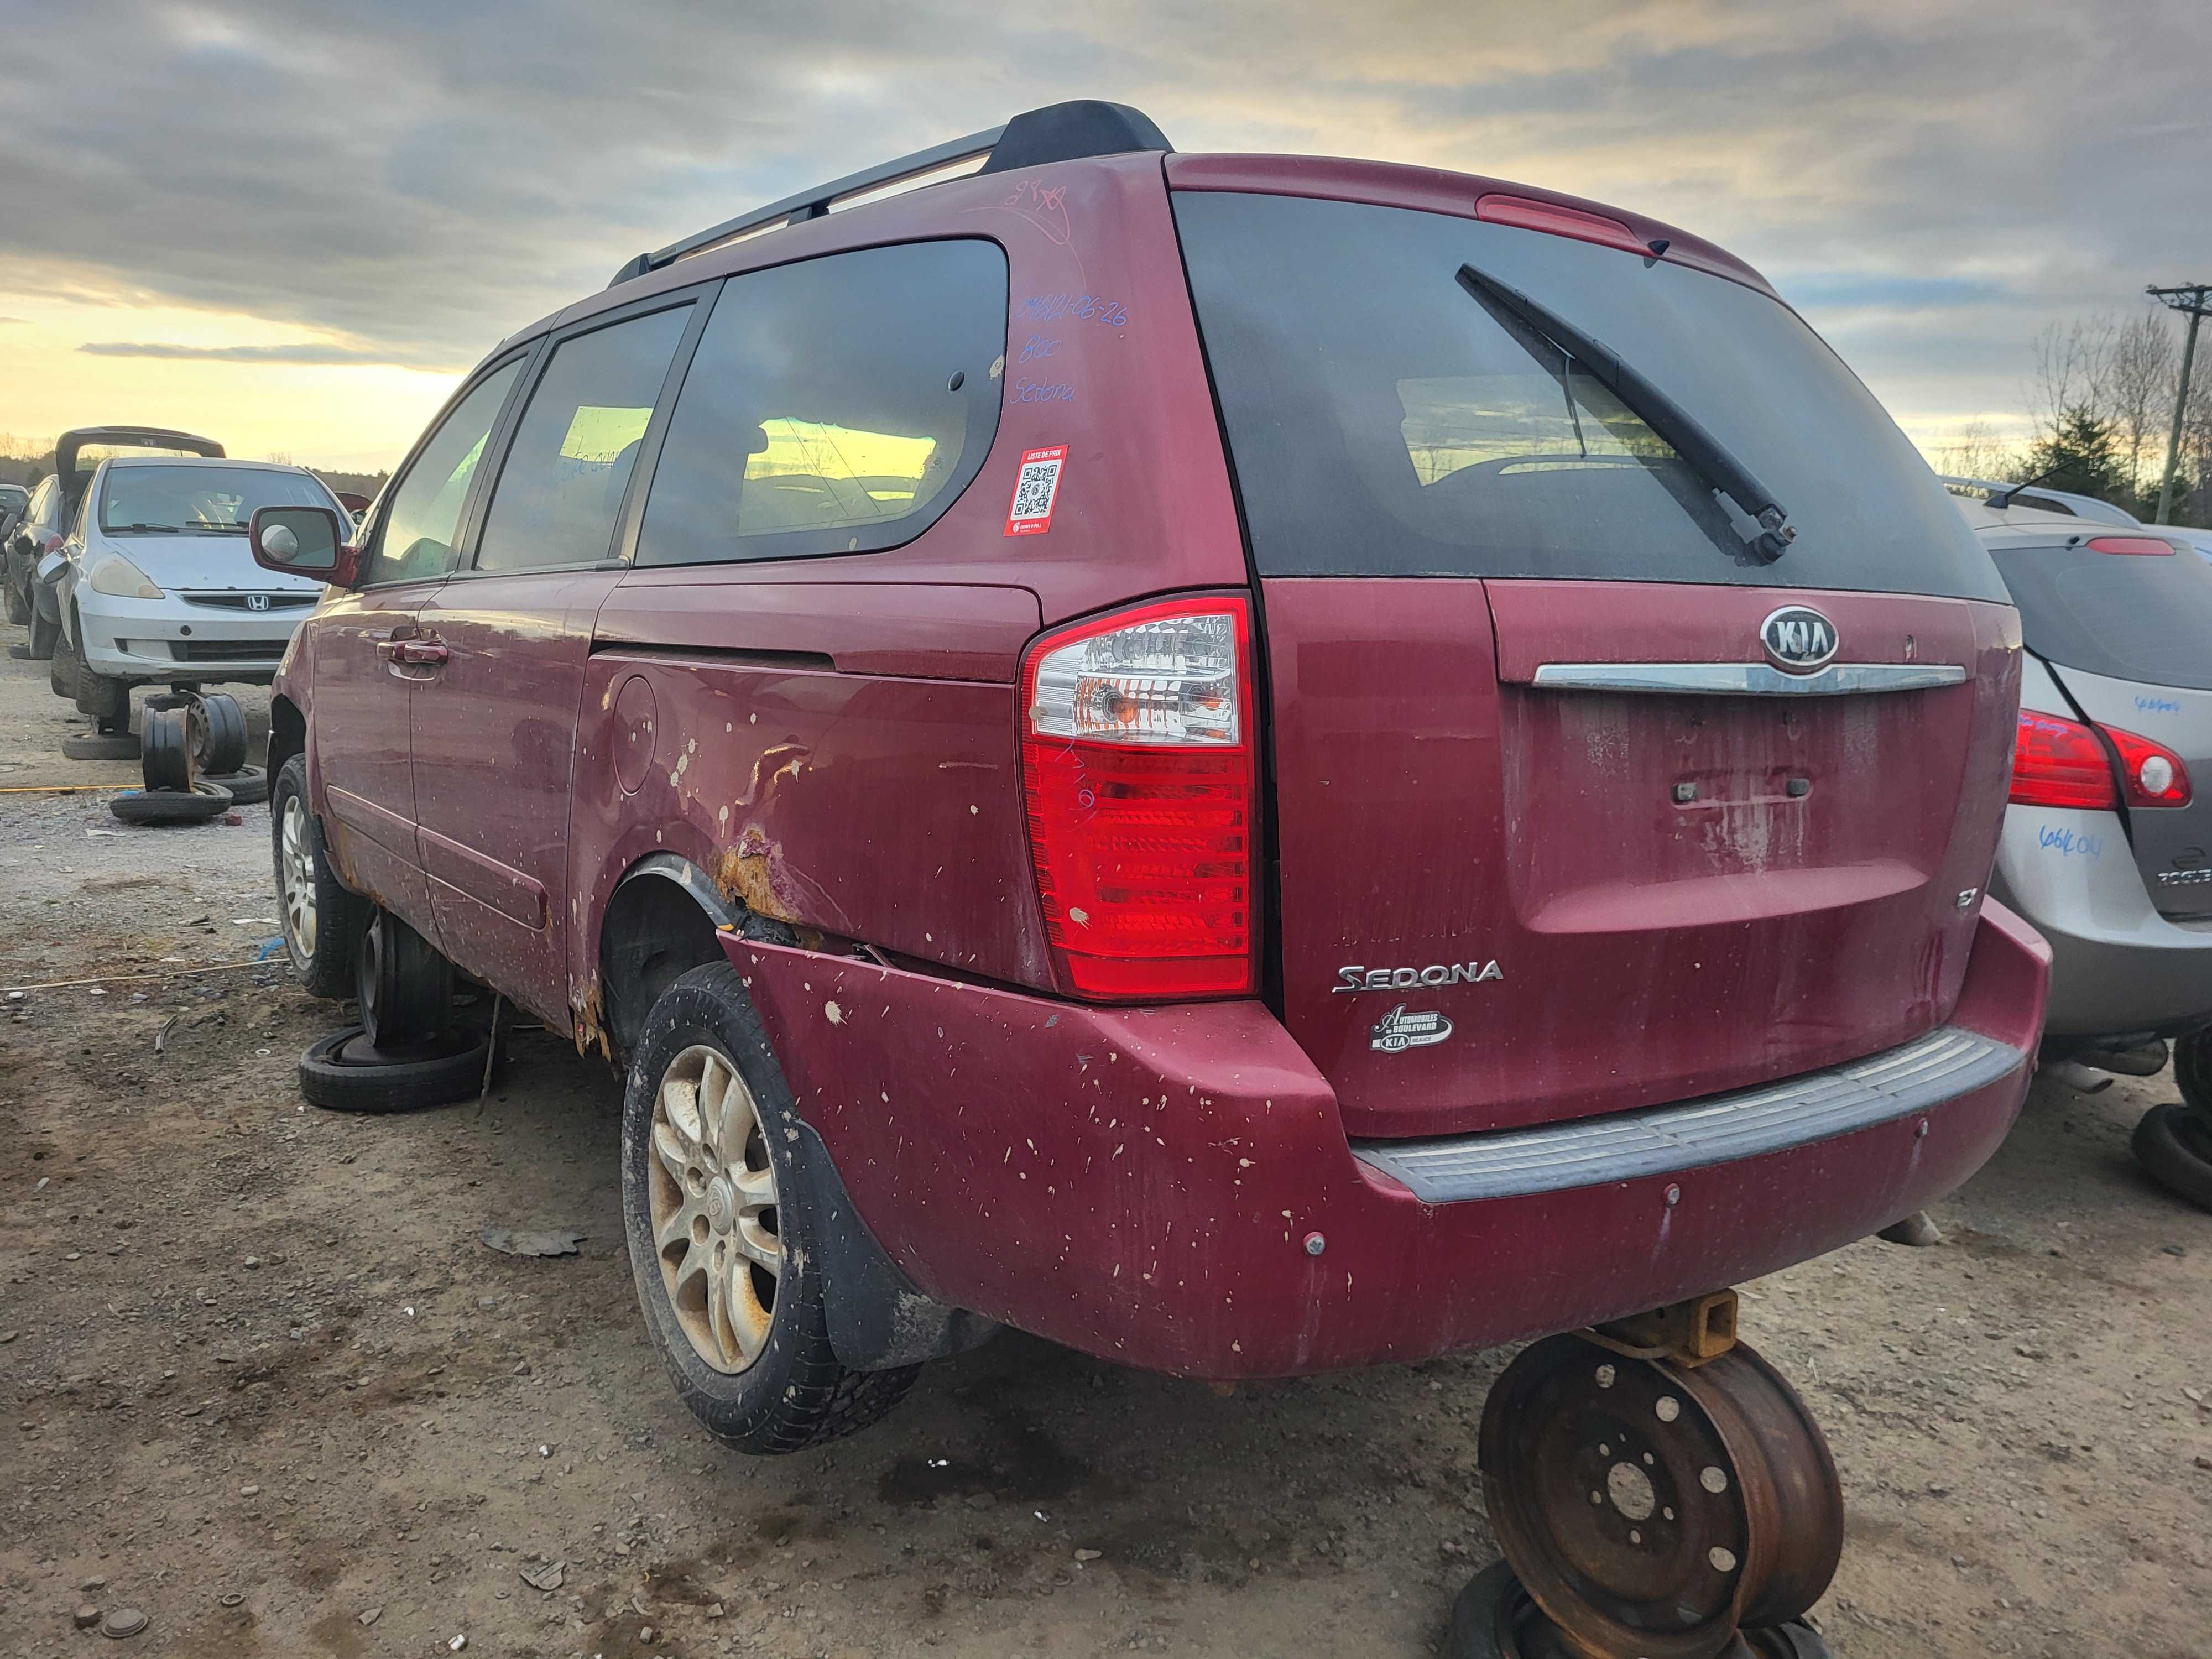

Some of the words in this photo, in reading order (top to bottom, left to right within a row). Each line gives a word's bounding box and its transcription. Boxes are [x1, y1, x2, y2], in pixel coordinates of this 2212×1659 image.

[1009, 377, 1075, 404] Sedona
[1027, 452, 1041, 460] LISTE
[1049, 449, 1062, 457] PRIX
[1774, 621, 1829, 653] KIA
[1331, 959, 1504, 993] SEDONA
[1374, 1005, 1438, 1032] AUTOMOBILES
[1393, 1022, 1437, 1034] BOULEVARD
[1385, 1037, 1406, 1047] KIA
